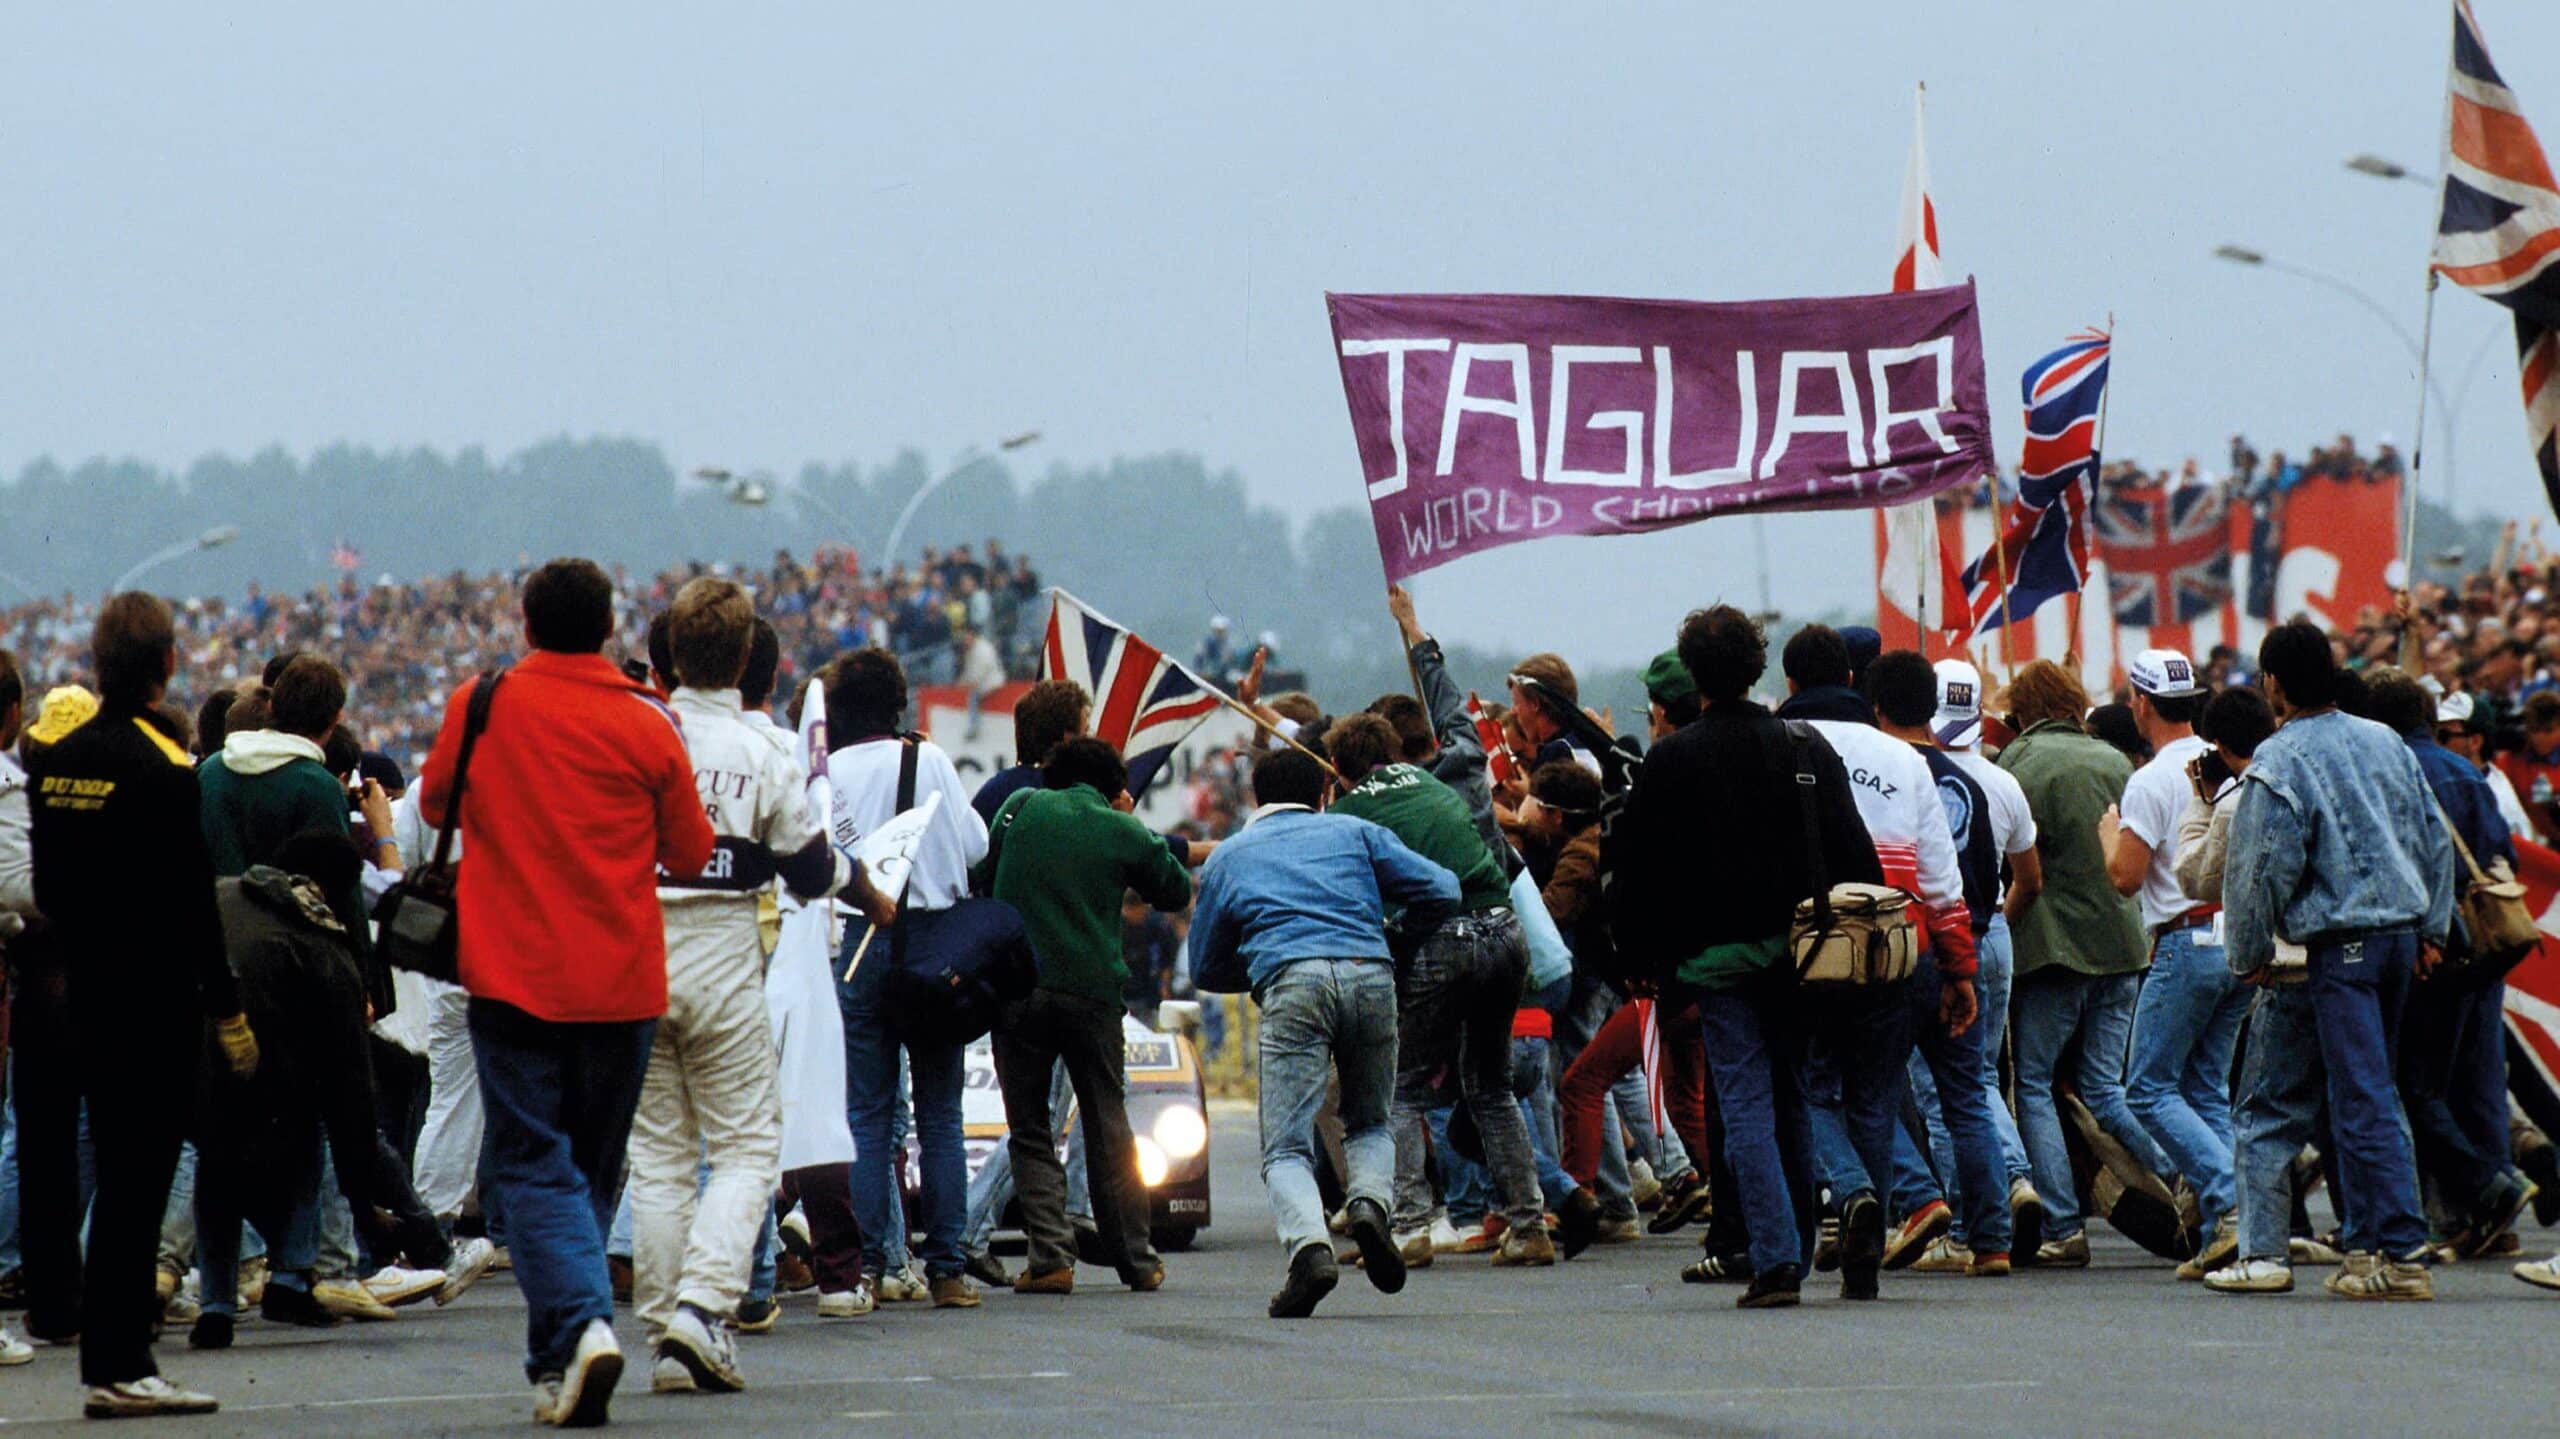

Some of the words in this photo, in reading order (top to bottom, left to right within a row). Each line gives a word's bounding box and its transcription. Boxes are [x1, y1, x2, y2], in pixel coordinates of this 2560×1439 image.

[1400, 487, 1563, 558] WORLD
[696, 768, 752, 799] CUT
[1851, 768, 1898, 800] GAZ
